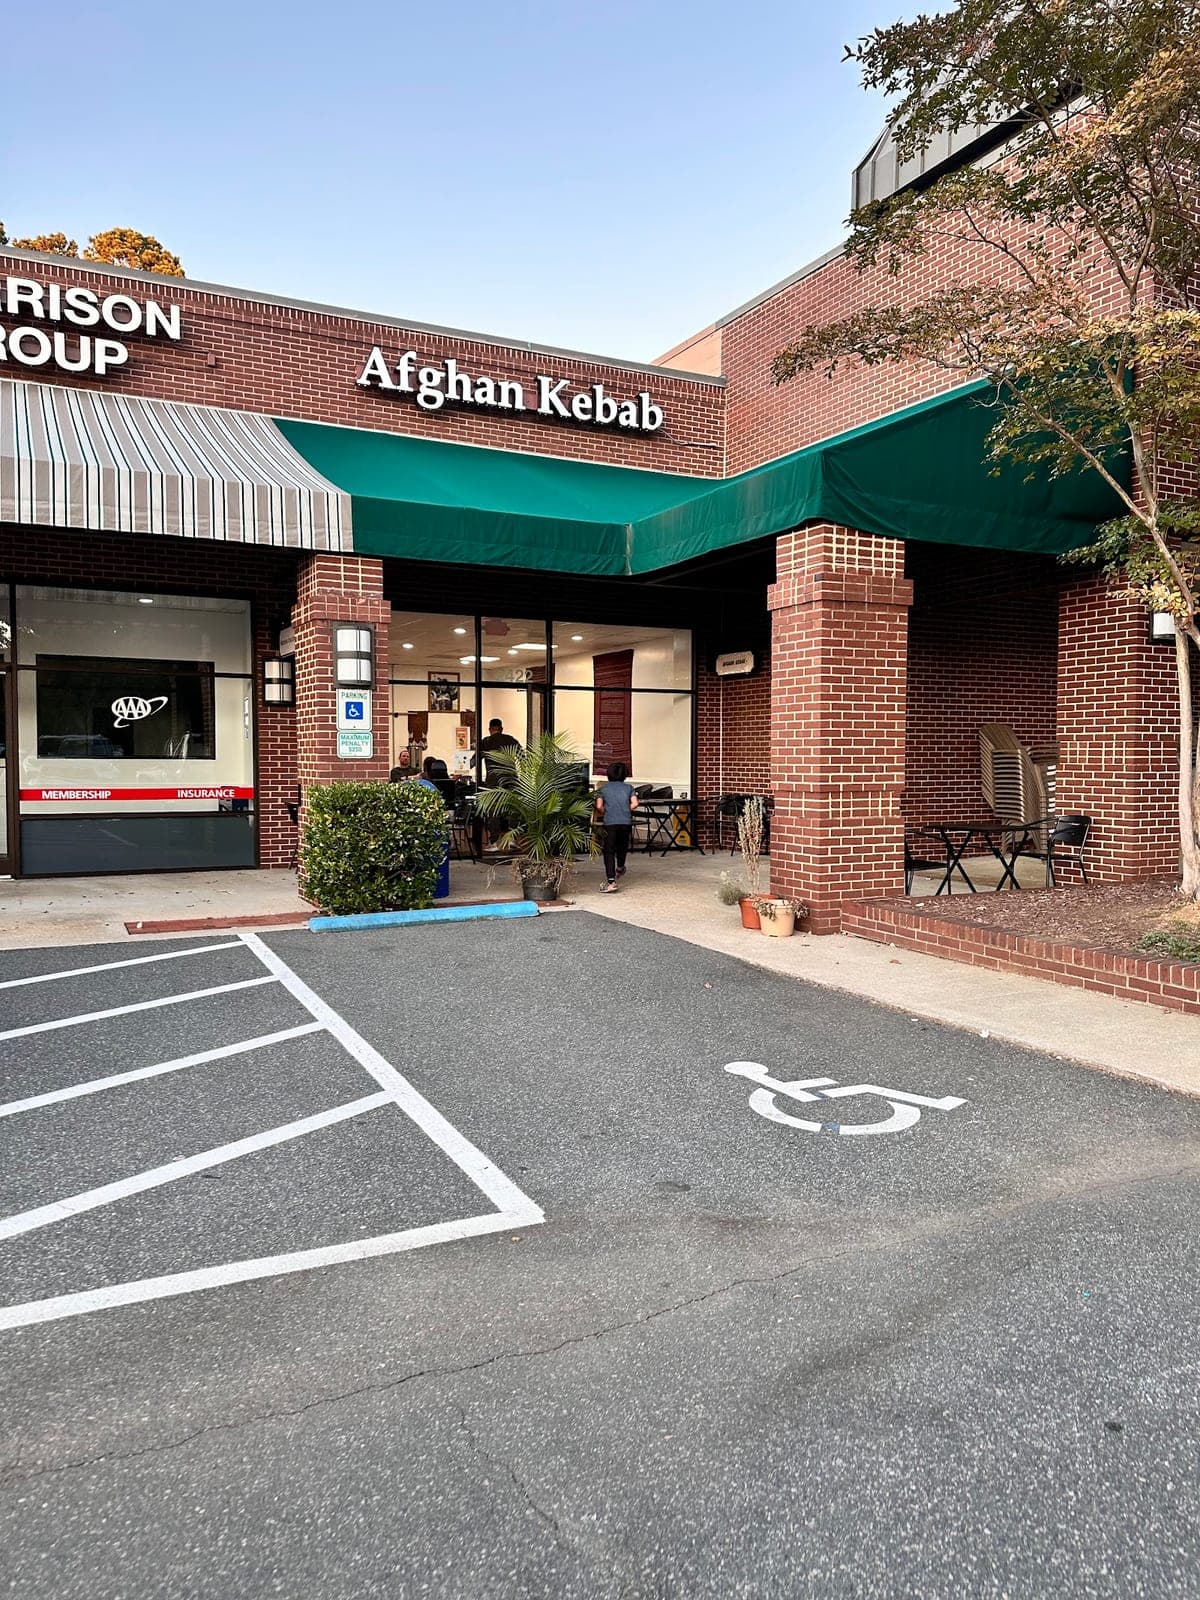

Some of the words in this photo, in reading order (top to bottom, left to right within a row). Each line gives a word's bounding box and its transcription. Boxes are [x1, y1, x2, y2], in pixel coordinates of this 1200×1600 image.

[0, 276, 181, 340] RISON
[0, 325, 128, 375] OUP
[356, 346, 526, 410] Afghan
[537, 375, 664, 431] Kebab
[41, 790, 111, 800] MEMBERSHIP
[177, 788, 236, 798] INSURANCE
